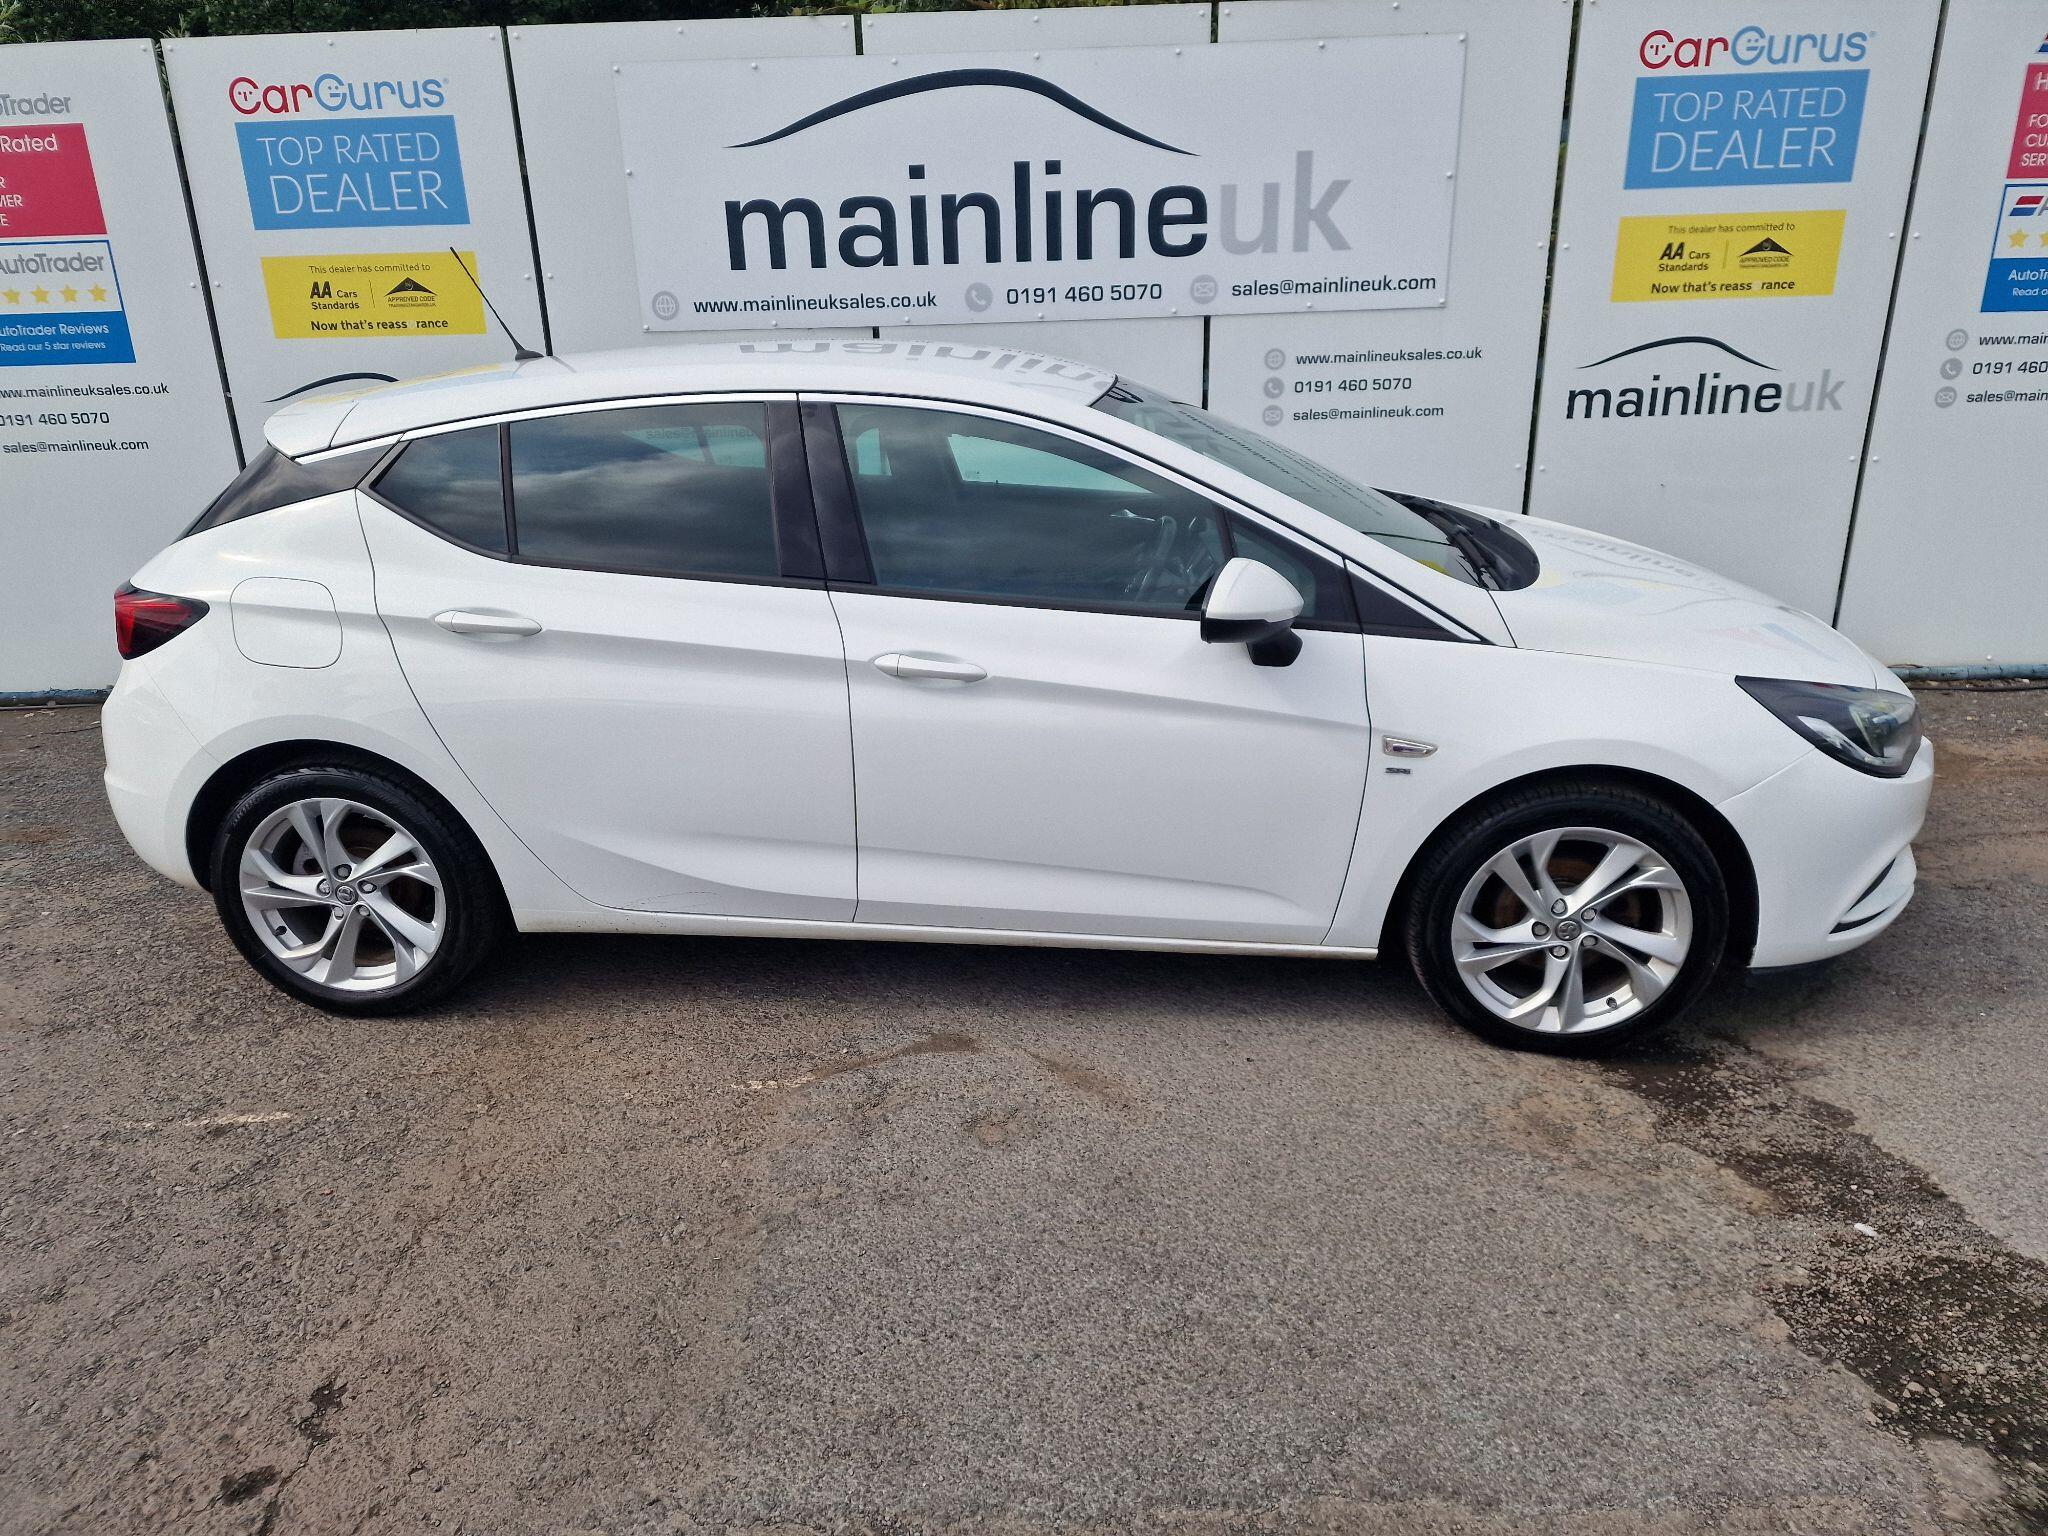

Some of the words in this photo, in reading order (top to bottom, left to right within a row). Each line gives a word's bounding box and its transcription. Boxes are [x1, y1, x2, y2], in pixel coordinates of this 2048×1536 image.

[1639, 25, 1868, 70] CarGurus
[229, 73, 446, 115] CarGurus
[0, 93, 71, 117] Trader
[1654, 91, 1724, 122] TOP
[1733, 87, 1846, 120] RATED
[0, 133, 58, 153] Rated
[256, 136, 323, 166] TOP
[333, 132, 441, 164] RATED
[1651, 127, 1836, 173] DEALER
[269, 171, 449, 215] DEALER
[723, 149, 1353, 271] mainlineuk
[1668, 225, 1688, 234] This
[1689, 224, 1717, 234] dealer
[1718, 224, 1734, 233] has
[1736, 222, 1783, 232] committed
[1786, 223, 1795, 231] to
[1659, 242, 1685, 260] AA
[1688, 250, 1710, 260] Cars
[309, 265, 327, 274] This
[329, 264, 355, 273] dealer
[357, 264, 372, 272] has
[374, 263, 419, 272] committed
[422, 263, 431, 271] to
[1658, 262, 1709, 272] Standards
[310, 281, 332, 299] AA
[336, 290, 358, 298] Cars
[1006, 287, 1057, 304] 0191
[1064, 285, 1103, 303] 460
[1110, 283, 1163, 301] 5070
[1231, 275, 1436, 298] sales@mainlineuk.com
[1651, 283, 1679, 294] Now
[1682, 281, 1717, 293] that's
[1719, 279, 1796, 291] reassrance
[2012, 287, 2039, 296] Read
[311, 301, 360, 310] Standards
[693, 291, 937, 313] www.mainlineuksales.co.uk
[59, 324, 110, 335] Reviews
[311, 321, 337, 331] Now
[340, 320, 374, 331] that's
[377, 319, 449, 330] reassrance
[0, 343, 25, 352] Read
[44, 342, 51, 350] 5
[52, 342, 69, 350] star
[72, 341, 106, 350] reviews
[1295, 346, 1483, 365] www.mainlineuksales.co.uk
[1972, 362, 2013, 374] 0191
[2017, 360, 2048, 373] 460
[1294, 380, 1332, 393] 0191
[1338, 379, 1368, 392] 460
[1372, 377, 1412, 390] 5070
[1566, 368, 1846, 420] mainlineuk
[38, 413, 67, 425] 460
[70, 412, 110, 424] 5070
[1293, 405, 1444, 421] sales@mainlineuk.com
[2, 439, 149, 453] sales@mainlineuk.com
